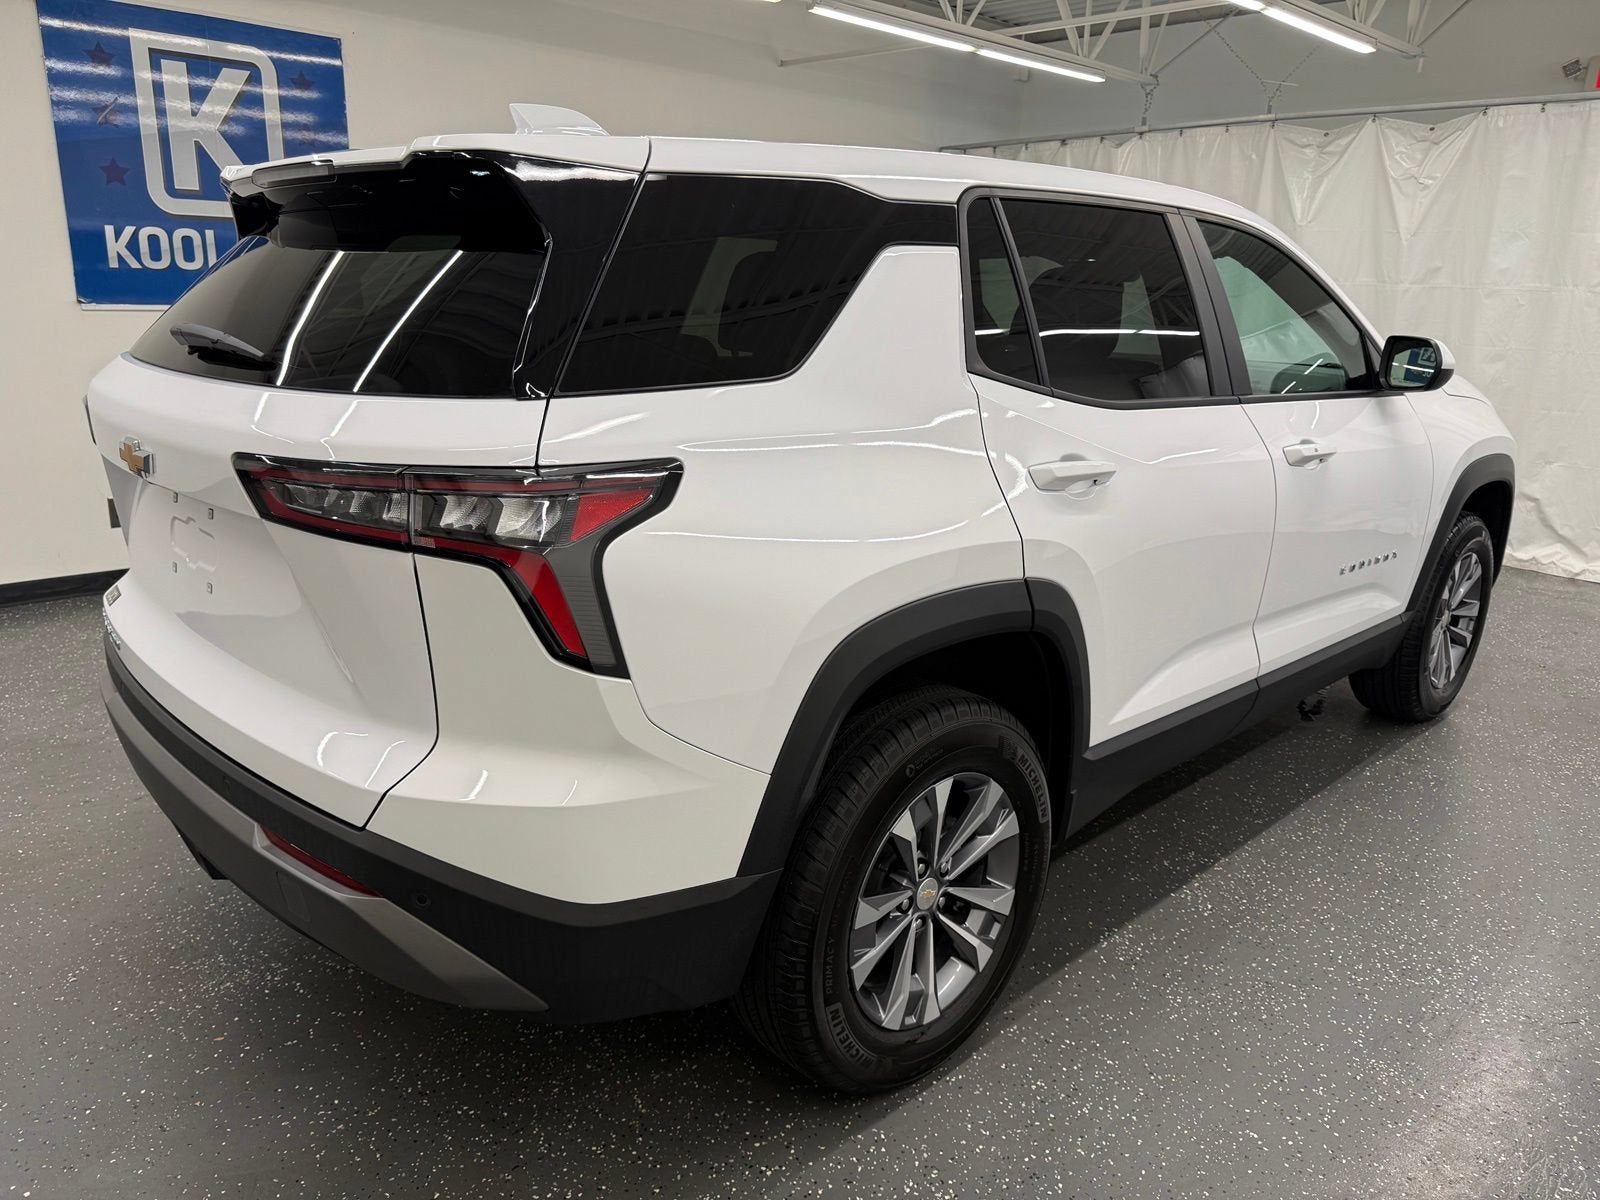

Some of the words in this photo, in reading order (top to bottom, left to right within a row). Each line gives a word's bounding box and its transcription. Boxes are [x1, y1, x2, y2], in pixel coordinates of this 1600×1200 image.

[160, 59, 251, 191] K
[1018, 754, 1048, 819] MICHELIN
[825, 937, 836, 994] PRIMACY
[829, 1007, 874, 1070] MICHELIN
